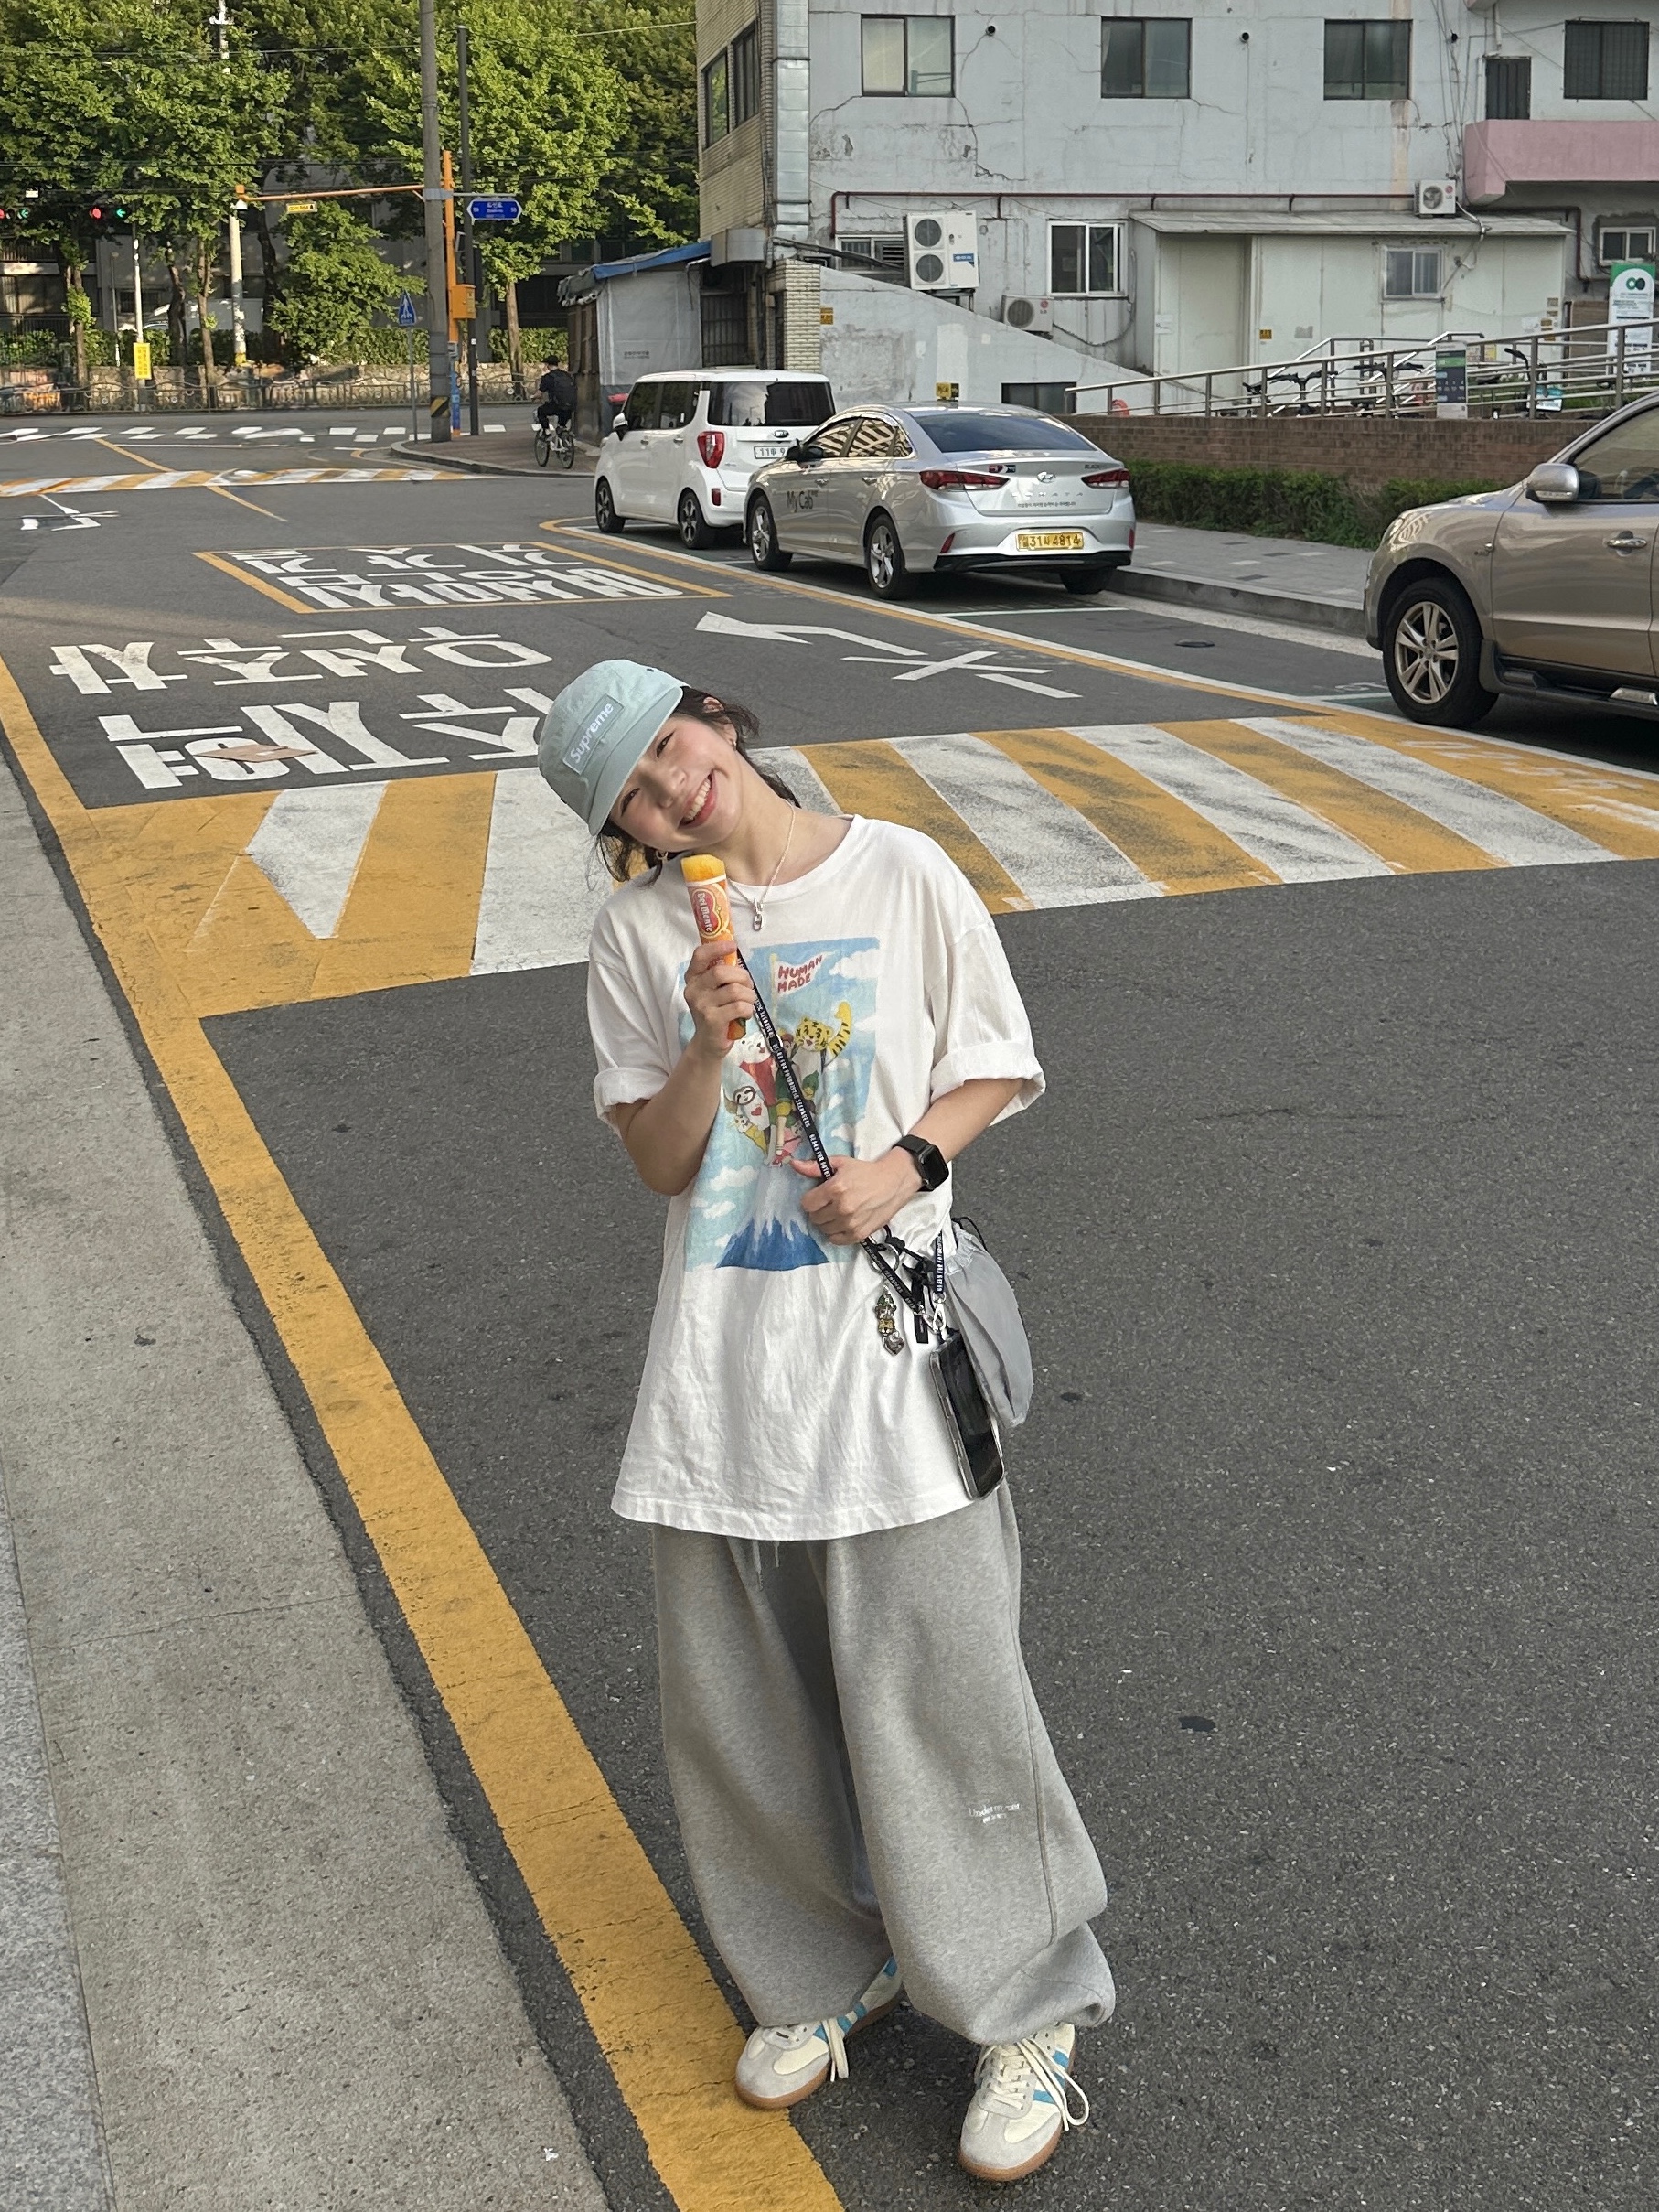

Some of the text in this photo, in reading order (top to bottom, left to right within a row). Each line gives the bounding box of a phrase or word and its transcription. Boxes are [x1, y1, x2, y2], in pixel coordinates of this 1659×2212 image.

[228, 543, 585, 574] 귀갓길
[1053, 533, 1081, 547] 4814
[276, 567, 684, 609] 여성안심
[48, 626, 553, 694] 우선주차
[97, 687, 555, 789] 주지역
[570, 703, 615, 764] Supreme
[697, 892, 713, 933] Del Monte
[777, 972, 811, 993] MADE
[778, 954, 823, 980] HUMAN
